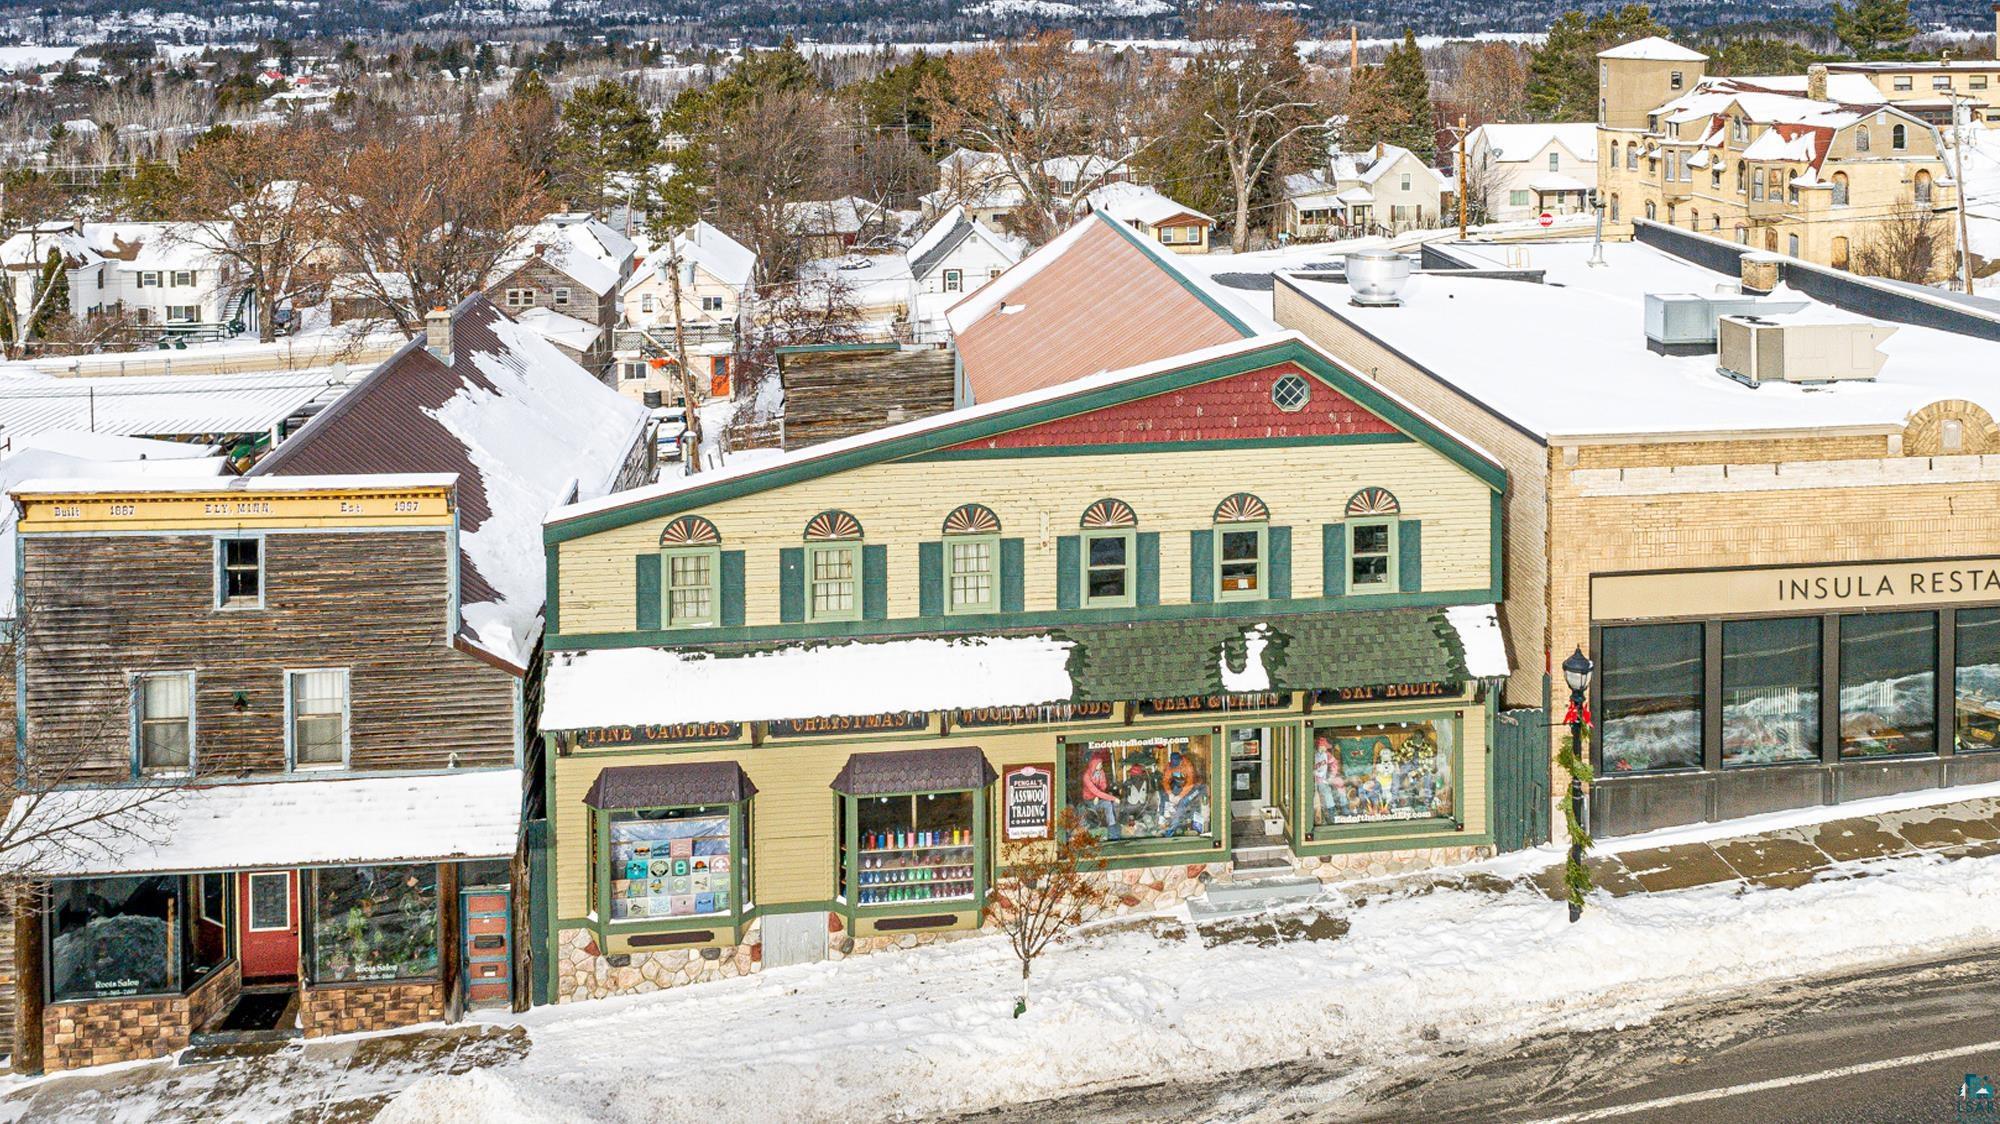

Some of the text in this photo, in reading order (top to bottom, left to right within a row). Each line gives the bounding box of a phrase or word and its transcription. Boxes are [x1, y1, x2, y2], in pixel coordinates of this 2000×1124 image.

[54, 507, 79, 517] Built
[205, 504, 232, 514] ELY,
[1779, 569, 2000, 600] INSULA RESTA
[1154, 695, 1200, 711] GEAR
[1208, 695, 1221, 709] &
[792, 712, 908, 732] CHRISTMAS
[587, 722, 731, 743] FINE CANDIES
[1010, 784, 1048, 806] BASSWOOD
[1011, 804, 1045, 818] TRADING
